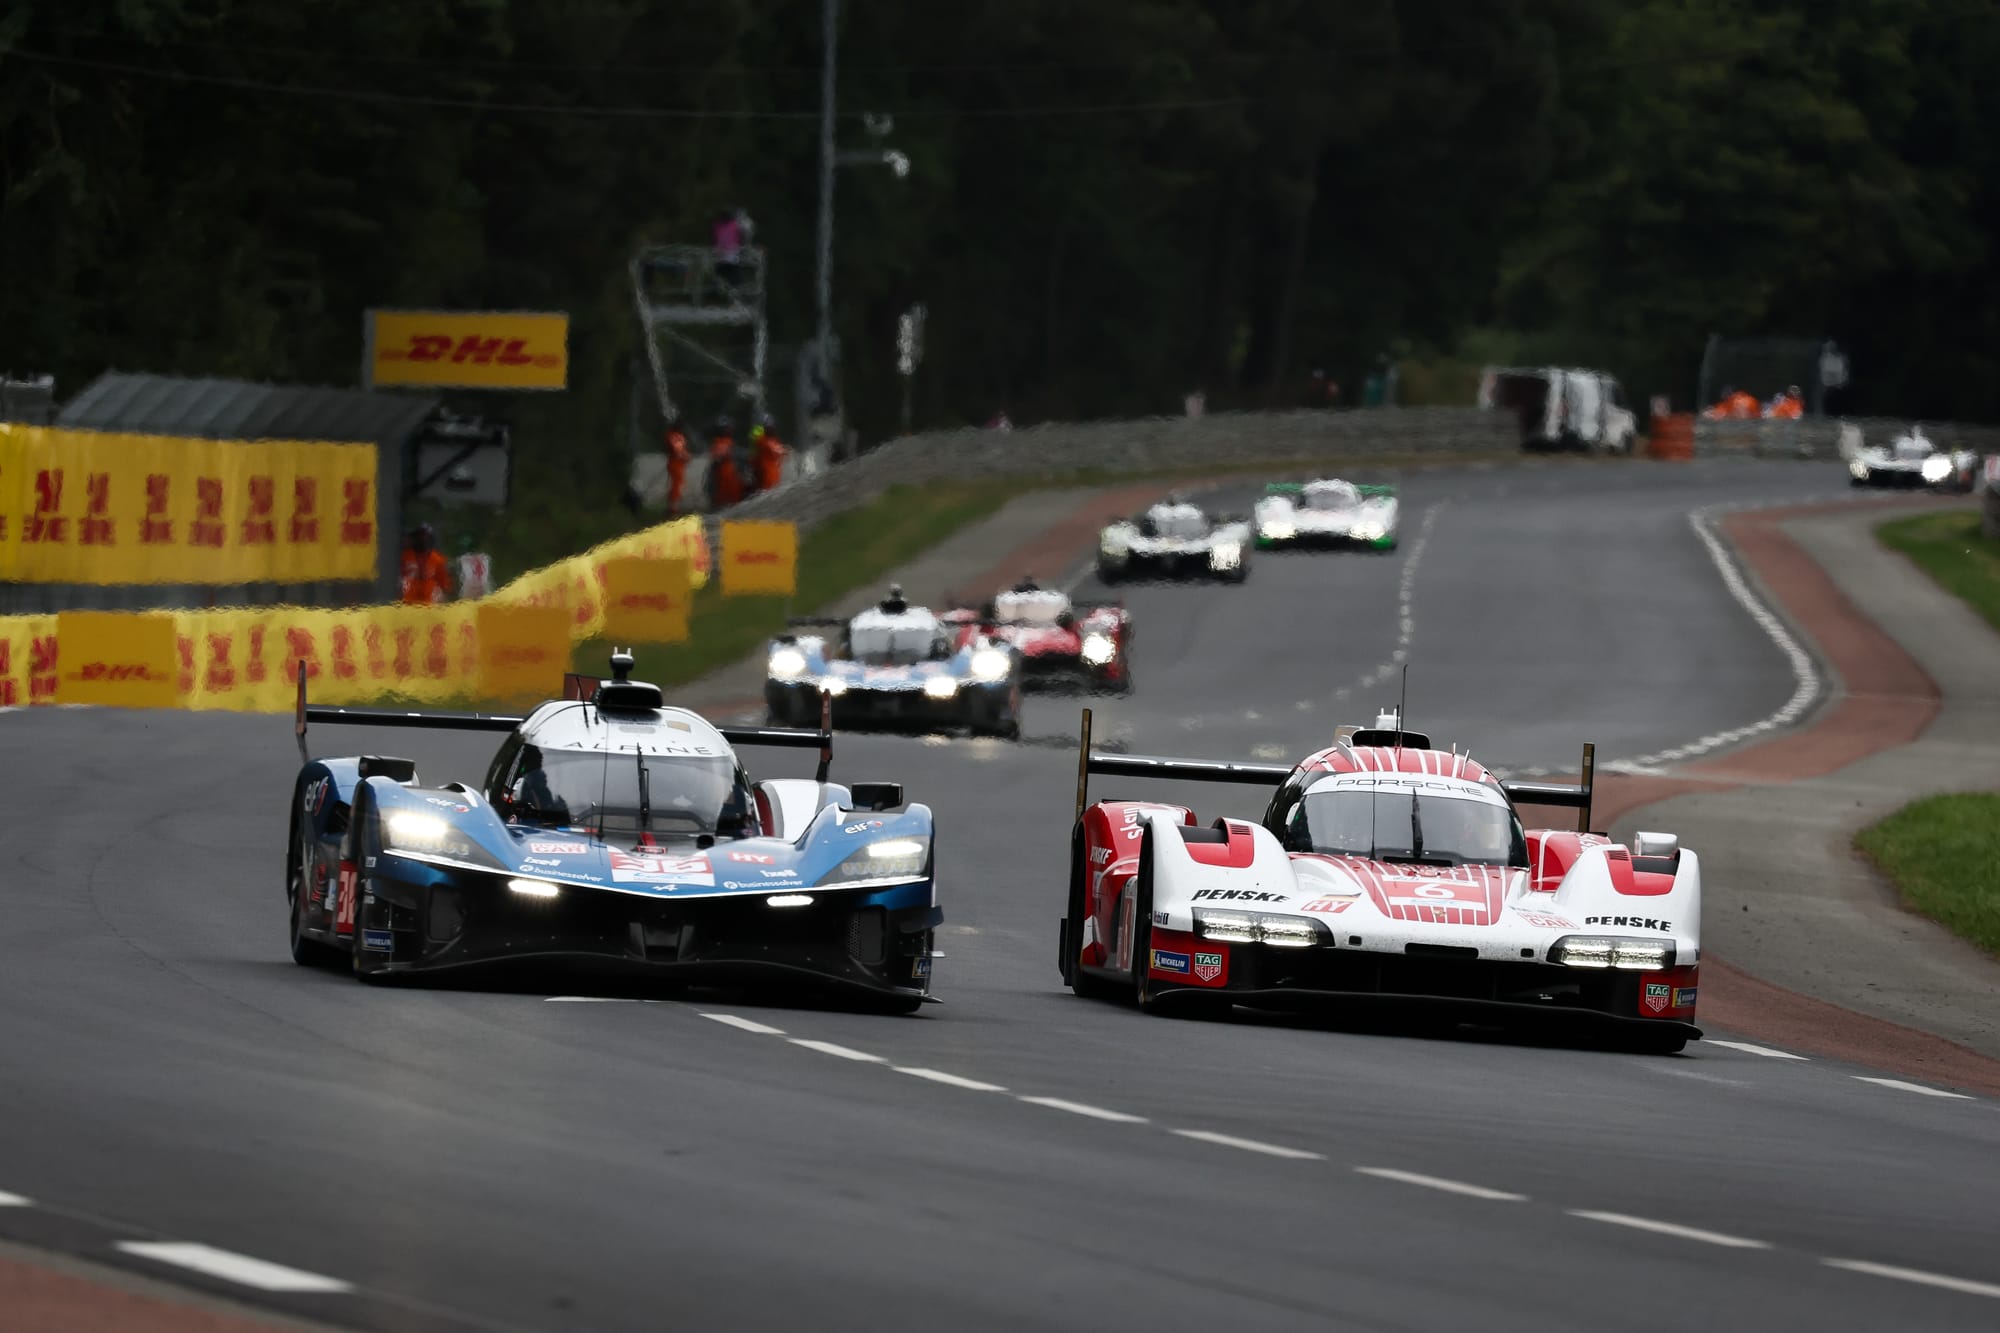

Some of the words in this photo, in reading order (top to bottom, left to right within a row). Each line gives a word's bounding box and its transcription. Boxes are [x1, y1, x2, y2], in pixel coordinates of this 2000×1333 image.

[407, 336, 533, 365] DHL
[564, 741, 713, 755] ALPINE
[1336, 779, 1484, 797] PORSCHE
[1191, 889, 1291, 903] PENSKE
[1413, 883, 1456, 899] 6
[1304, 901, 1348, 912] HY
[1585, 916, 1672, 932] PENSKE
[1160, 957, 1186, 968] MICHELIN
[1198, 955, 1219, 965] TAG
[1196, 965, 1221, 980] HEUER
[1649, 986, 1668, 996] TAG
[1647, 996, 1669, 1011] HEUER
